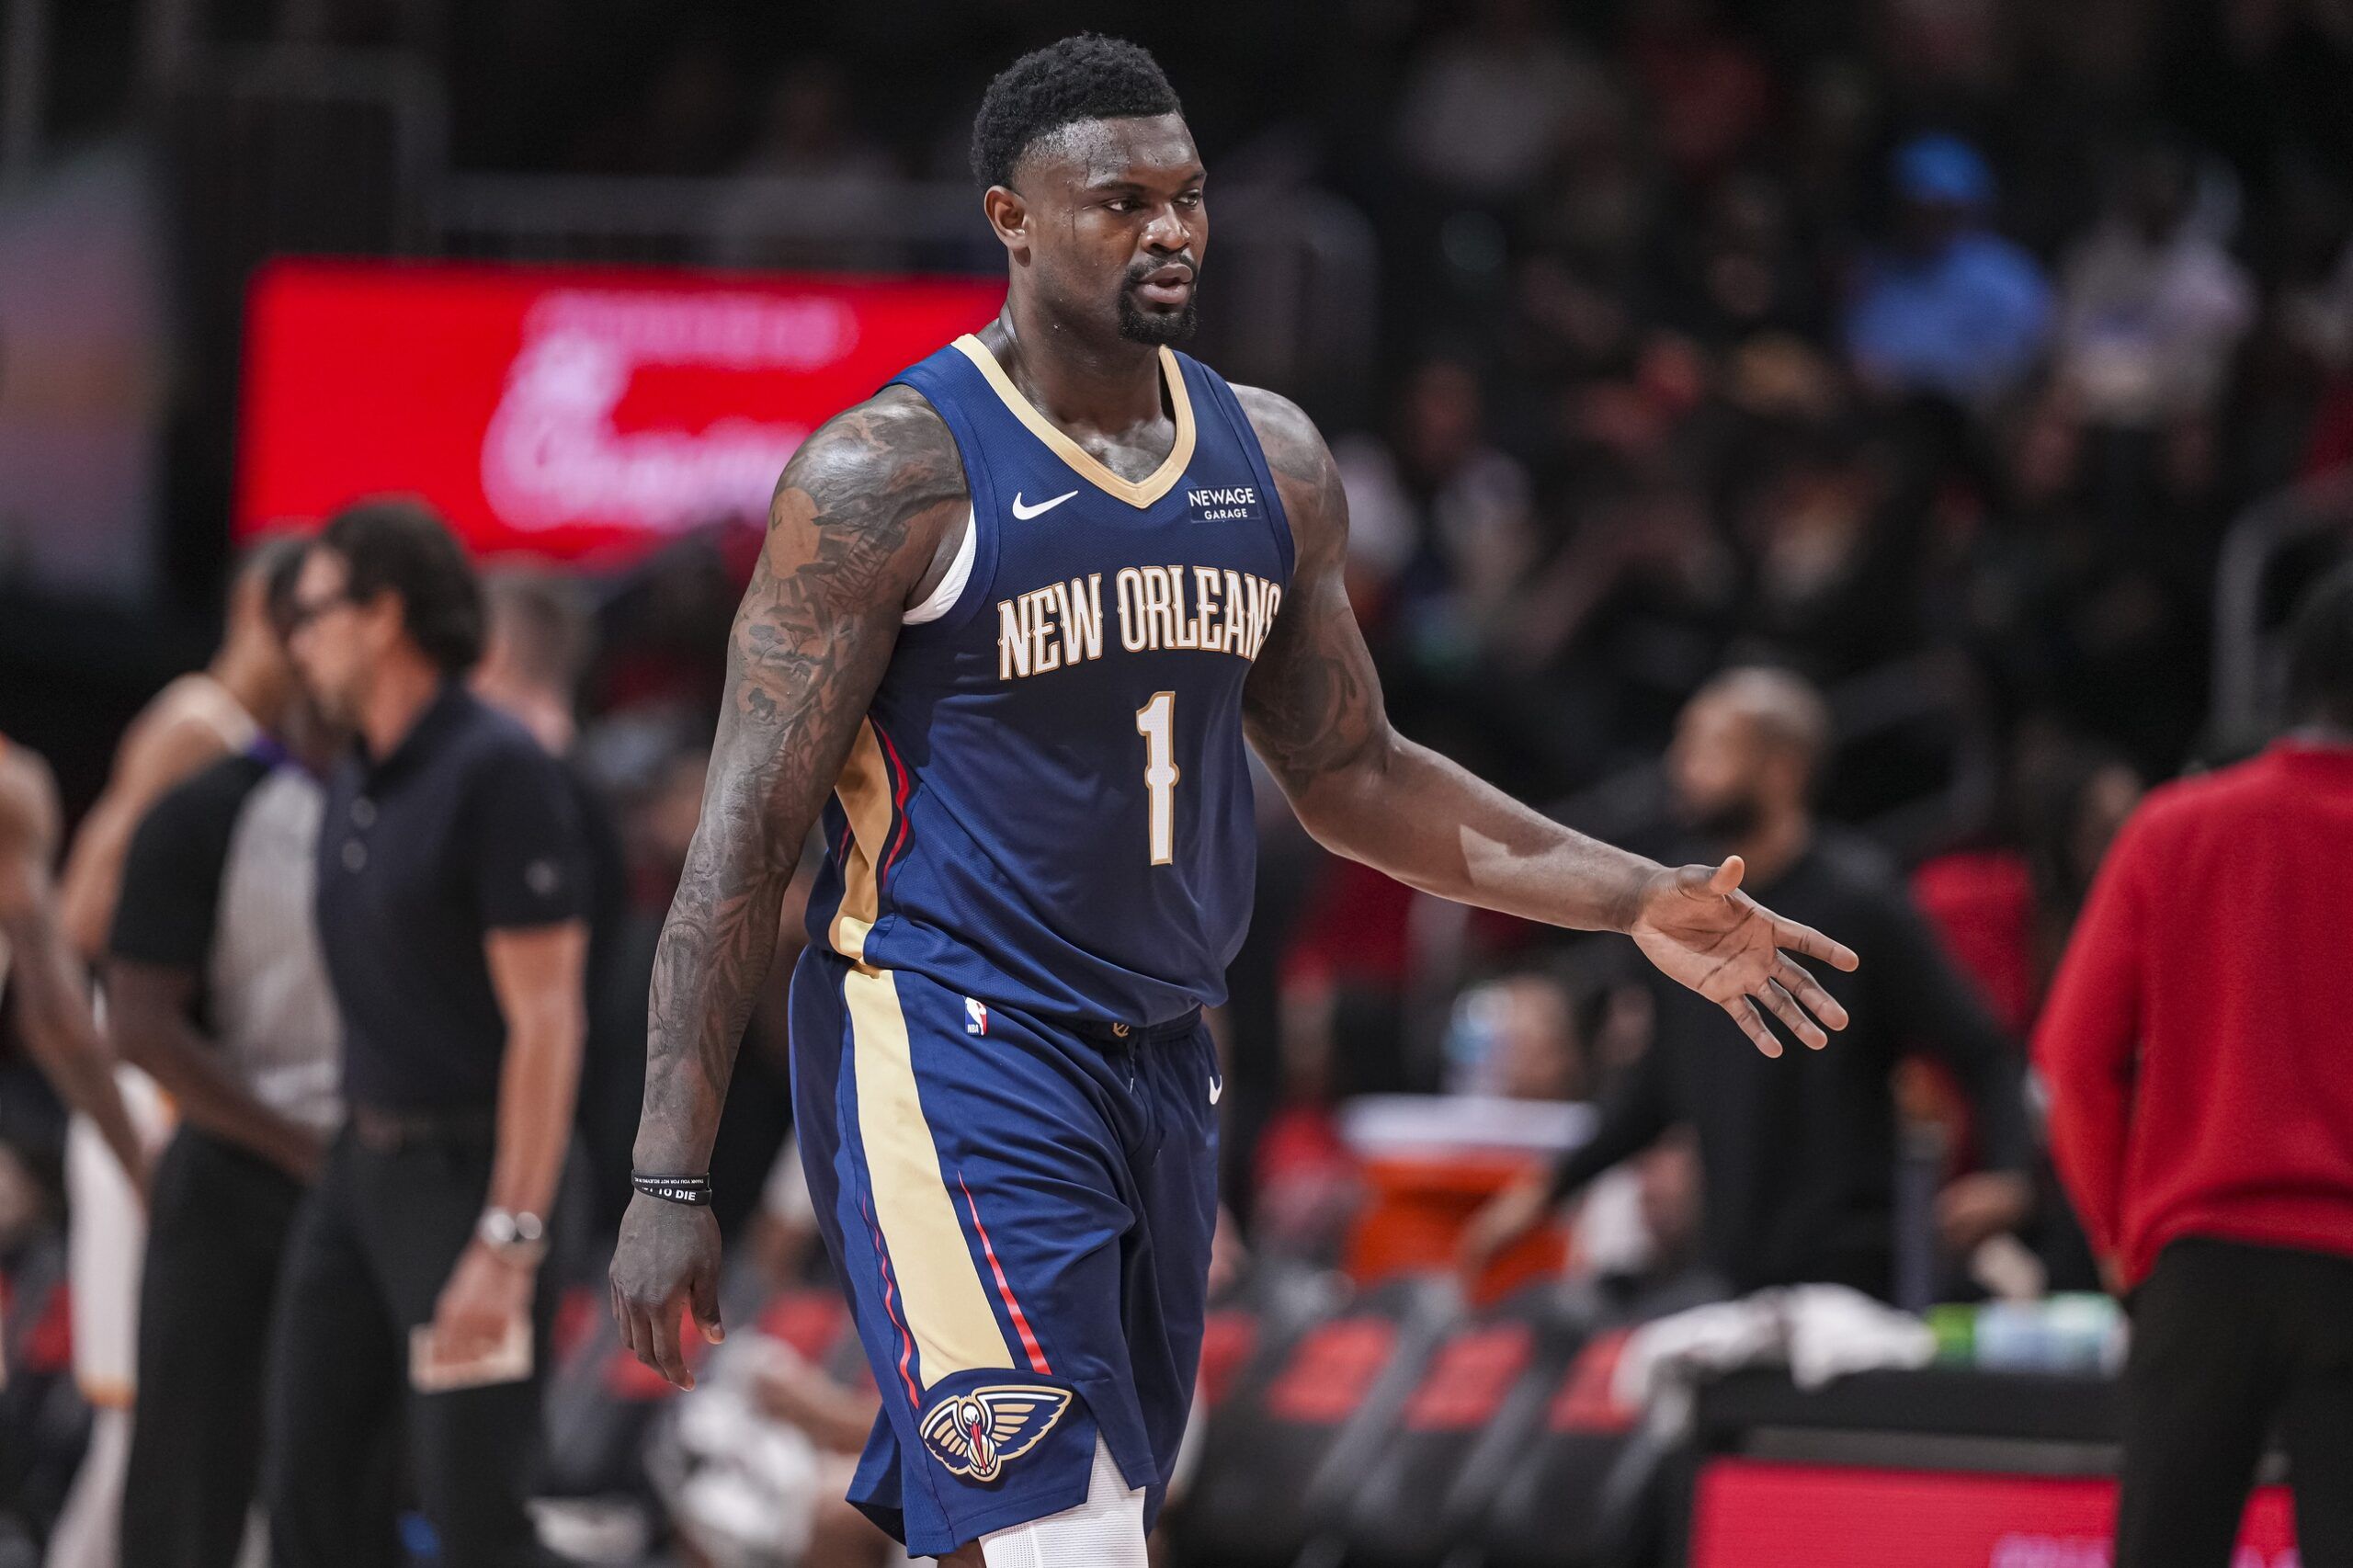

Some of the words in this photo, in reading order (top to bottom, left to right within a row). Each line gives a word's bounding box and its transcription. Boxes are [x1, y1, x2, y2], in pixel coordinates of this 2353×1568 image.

[1188, 487, 1256, 507] NEWAGE
[1204, 508, 1248, 520] GARAGE
[998, 573, 1103, 680] NEW
[1136, 691, 1180, 866] 1
[967, 1023, 980, 1034] NBA
[675, 1189, 697, 1201] DIE
